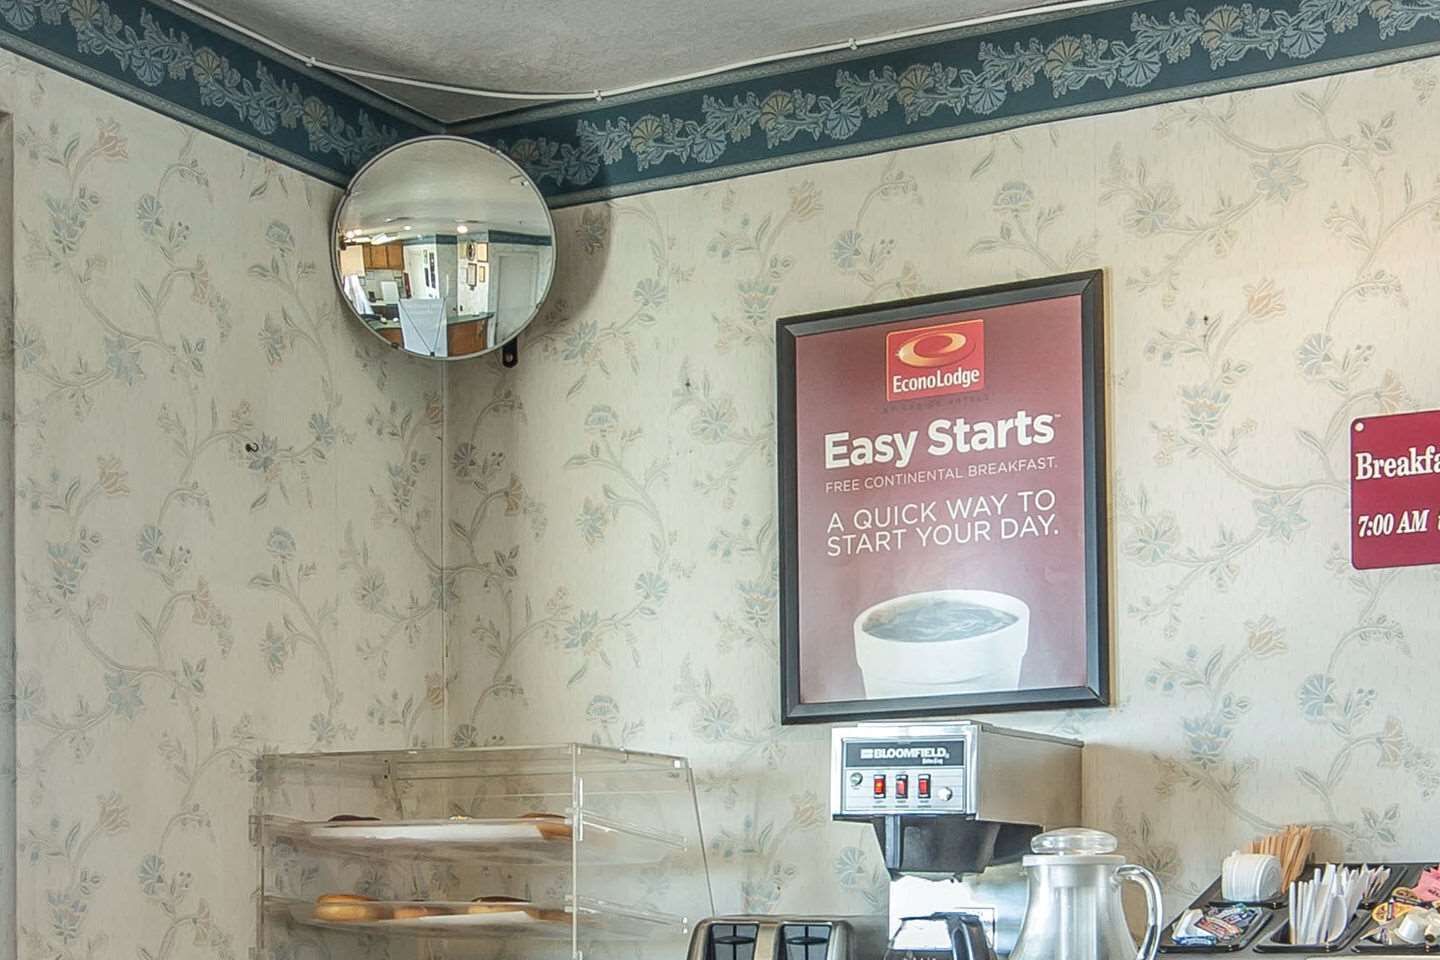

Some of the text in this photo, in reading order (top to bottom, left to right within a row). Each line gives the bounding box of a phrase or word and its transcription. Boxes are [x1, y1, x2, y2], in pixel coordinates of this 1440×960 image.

[893, 367, 980, 393] EconoLodge
[823, 427, 919, 469] Easy
[825, 479, 860, 493] FREE
[864, 468, 963, 489] CONTINENTAL
[827, 489, 1055, 533] A QUICK WAY TO
[1358, 513, 1394, 537] 7:00
[1396, 509, 1429, 533] AM
[827, 514, 1059, 556] START YOUR DAY.
[874, 748, 946, 759] BLOOMFIELD
